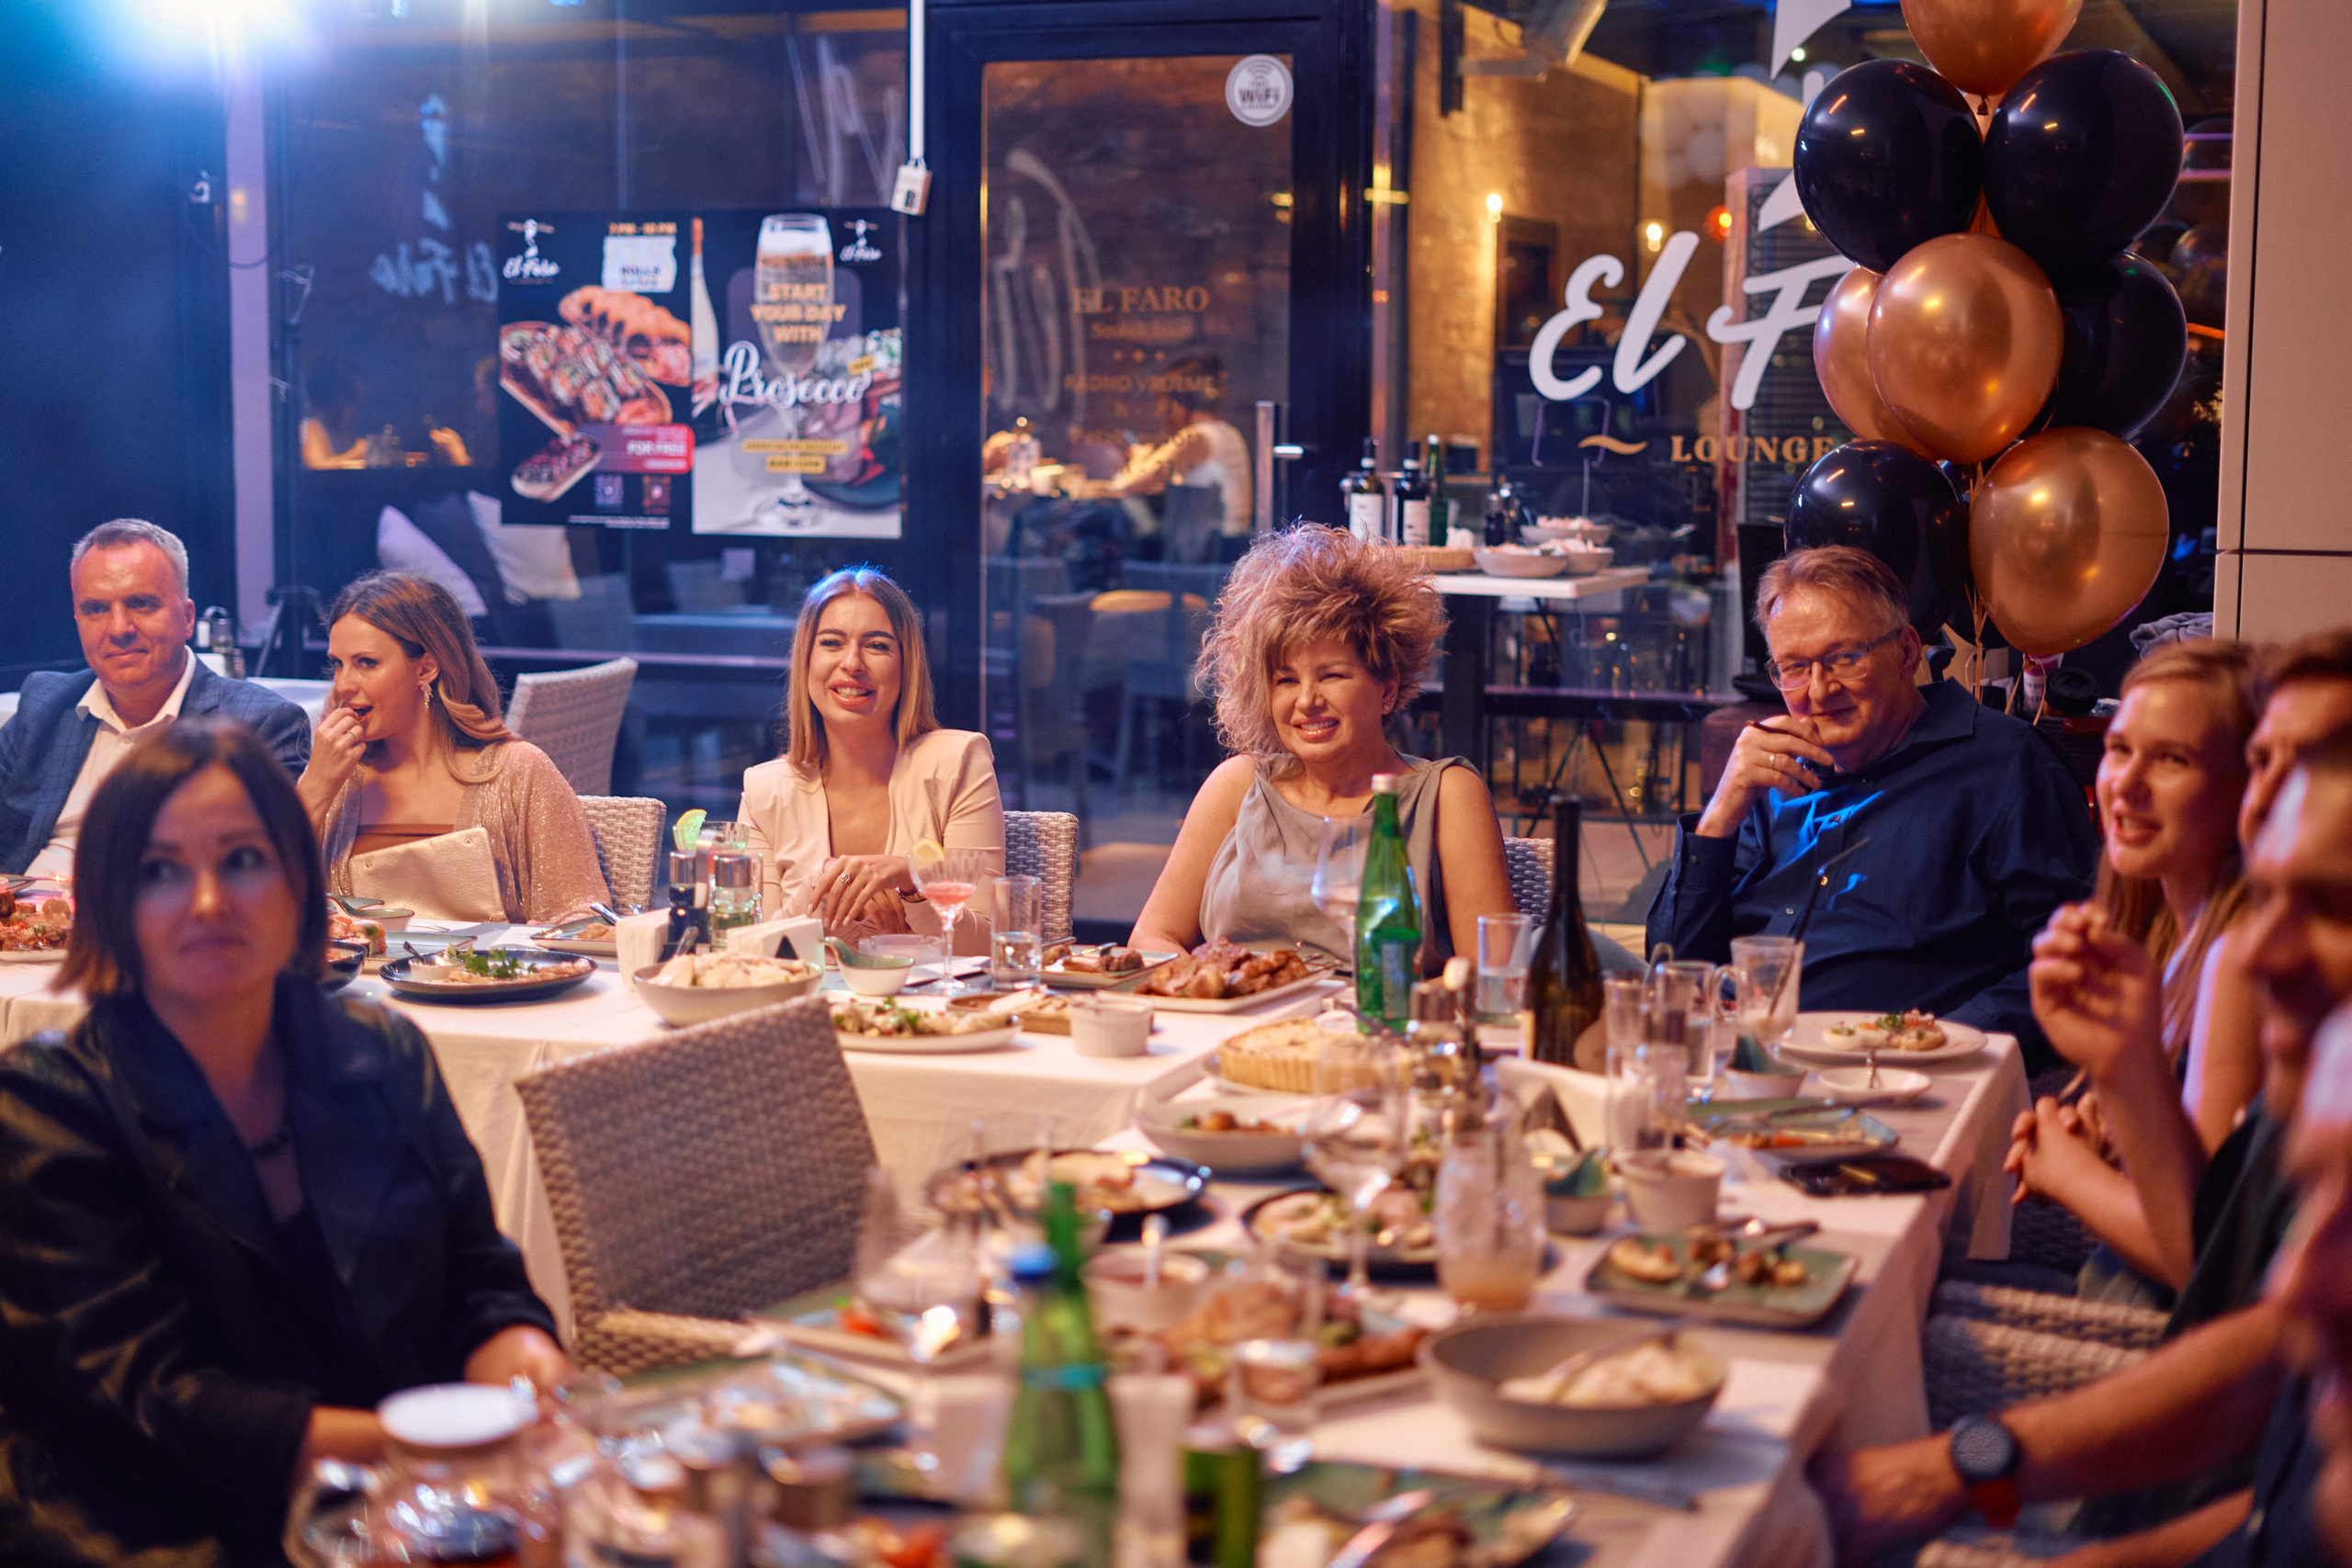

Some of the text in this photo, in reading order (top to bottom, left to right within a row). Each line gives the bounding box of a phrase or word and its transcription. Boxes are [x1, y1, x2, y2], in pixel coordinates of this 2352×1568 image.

[503, 254, 523, 278] El
[768, 283, 827, 300] START
[1073, 286, 1209, 313] EL FARO
[749, 304, 846, 321] YOUR DAY
[1529, 231, 1700, 401] El
[774, 325, 822, 343] WITH
[718, 340, 872, 409] Prosecco
[1671, 435, 1834, 463] LOUNGE
